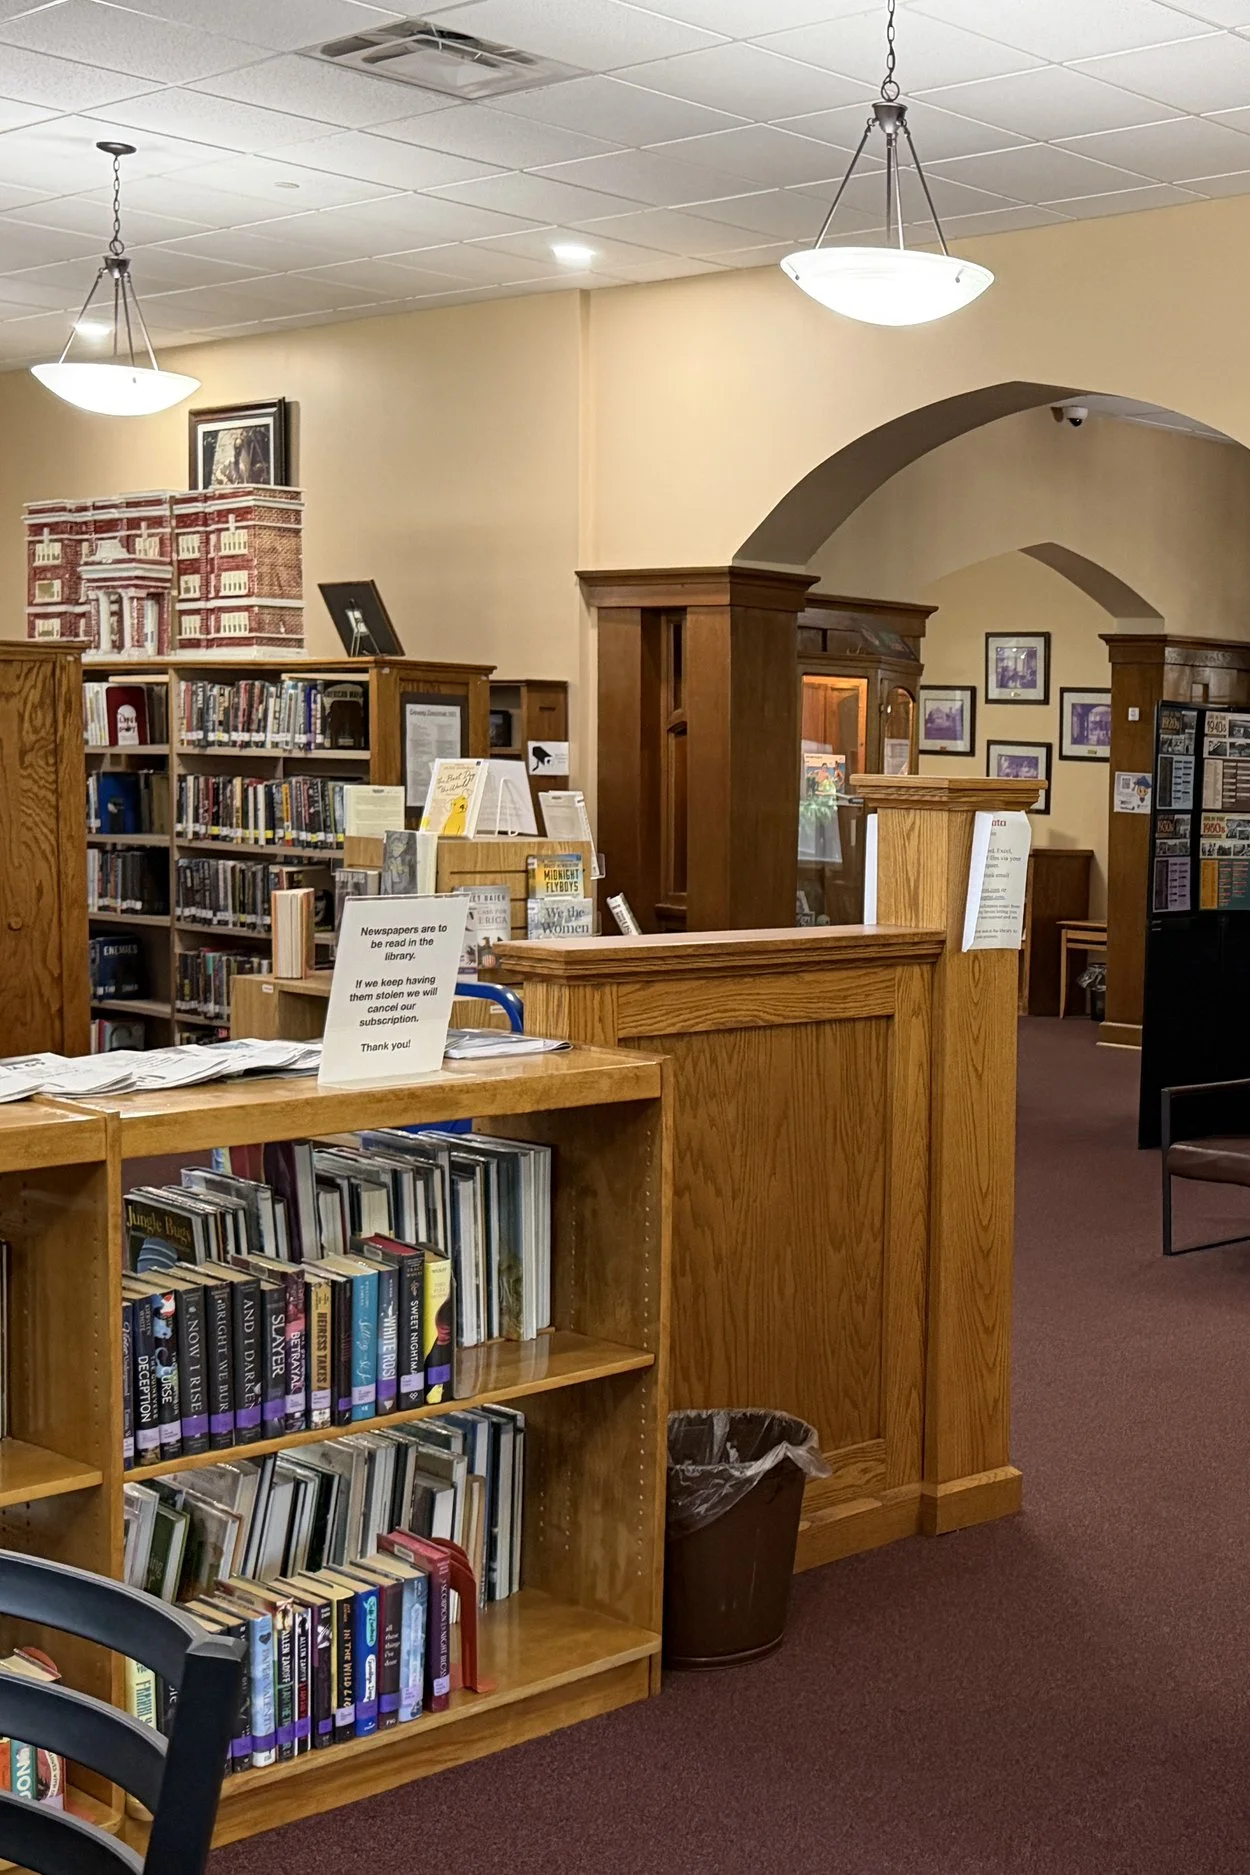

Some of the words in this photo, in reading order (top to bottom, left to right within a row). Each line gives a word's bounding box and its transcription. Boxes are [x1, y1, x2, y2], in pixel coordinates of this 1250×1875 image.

[1203, 823, 1226, 834] 1950s
[544, 869, 579, 881] MIDNIGHT
[546, 881, 579, 893] FLYBOYS
[546, 907, 564, 918] We
[567, 906, 585, 918] the
[360, 926, 419, 936] Newspapers
[421, 925, 436, 933] are
[438, 924, 447, 933] to
[541, 922, 589, 934] Women
[371, 940, 383, 949] be
[385, 938, 406, 948] read
[408, 938, 416, 947] in
[419, 937, 434, 946] the
[385, 952, 416, 961] library.
[355, 979, 363, 989] If
[381, 977, 404, 988] keep
[406, 975, 436, 985] having
[349, 992, 373, 1002] them
[376, 991, 404, 1000] stolen
[407, 990, 420, 998] we
[423, 987, 438, 996] will
[367, 1003, 398, 1014] cancel
[400, 1003, 416, 1011] our
[359, 1015, 419, 1027] subscription.
[361, 1042, 389, 1052] Thank
[391, 1039, 411, 1051] you!
[127, 1205, 162, 1234] Jungle
[165, 1216, 192, 1244] Bugs
[243, 1299, 255, 1333] AND
[410, 1300, 419, 1330] SWEET
[187, 1319, 200, 1357] NOW
[217, 1303, 228, 1354] BRIGHT
[317, 1312, 328, 1351] HEIRESS
[383, 1315, 397, 1352] WHITE
[272, 1314, 285, 1378] SLAYER
[410, 1334, 419, 1374] NIGHTMA
[190, 1364, 199, 1372] I
[218, 1360, 228, 1381] WE
[290, 1331, 301, 1390] BETRAYAL
[317, 1353, 328, 1383] TAKES
[138, 1355, 151, 1423] DECEPTION
[190, 1376, 201, 1412] RISE
[218, 1384, 229, 1413] BUR
[281, 1630, 292, 1654] ALLEN
[343, 1629, 351, 1640] IN
[299, 1636, 307, 1657] ALLEN
[343, 1642, 352, 1658] THE
[282, 1656, 292, 1682] ZADOFF
[343, 1659, 352, 1687] WILD
[262, 1681, 273, 1734] VALENTIN
